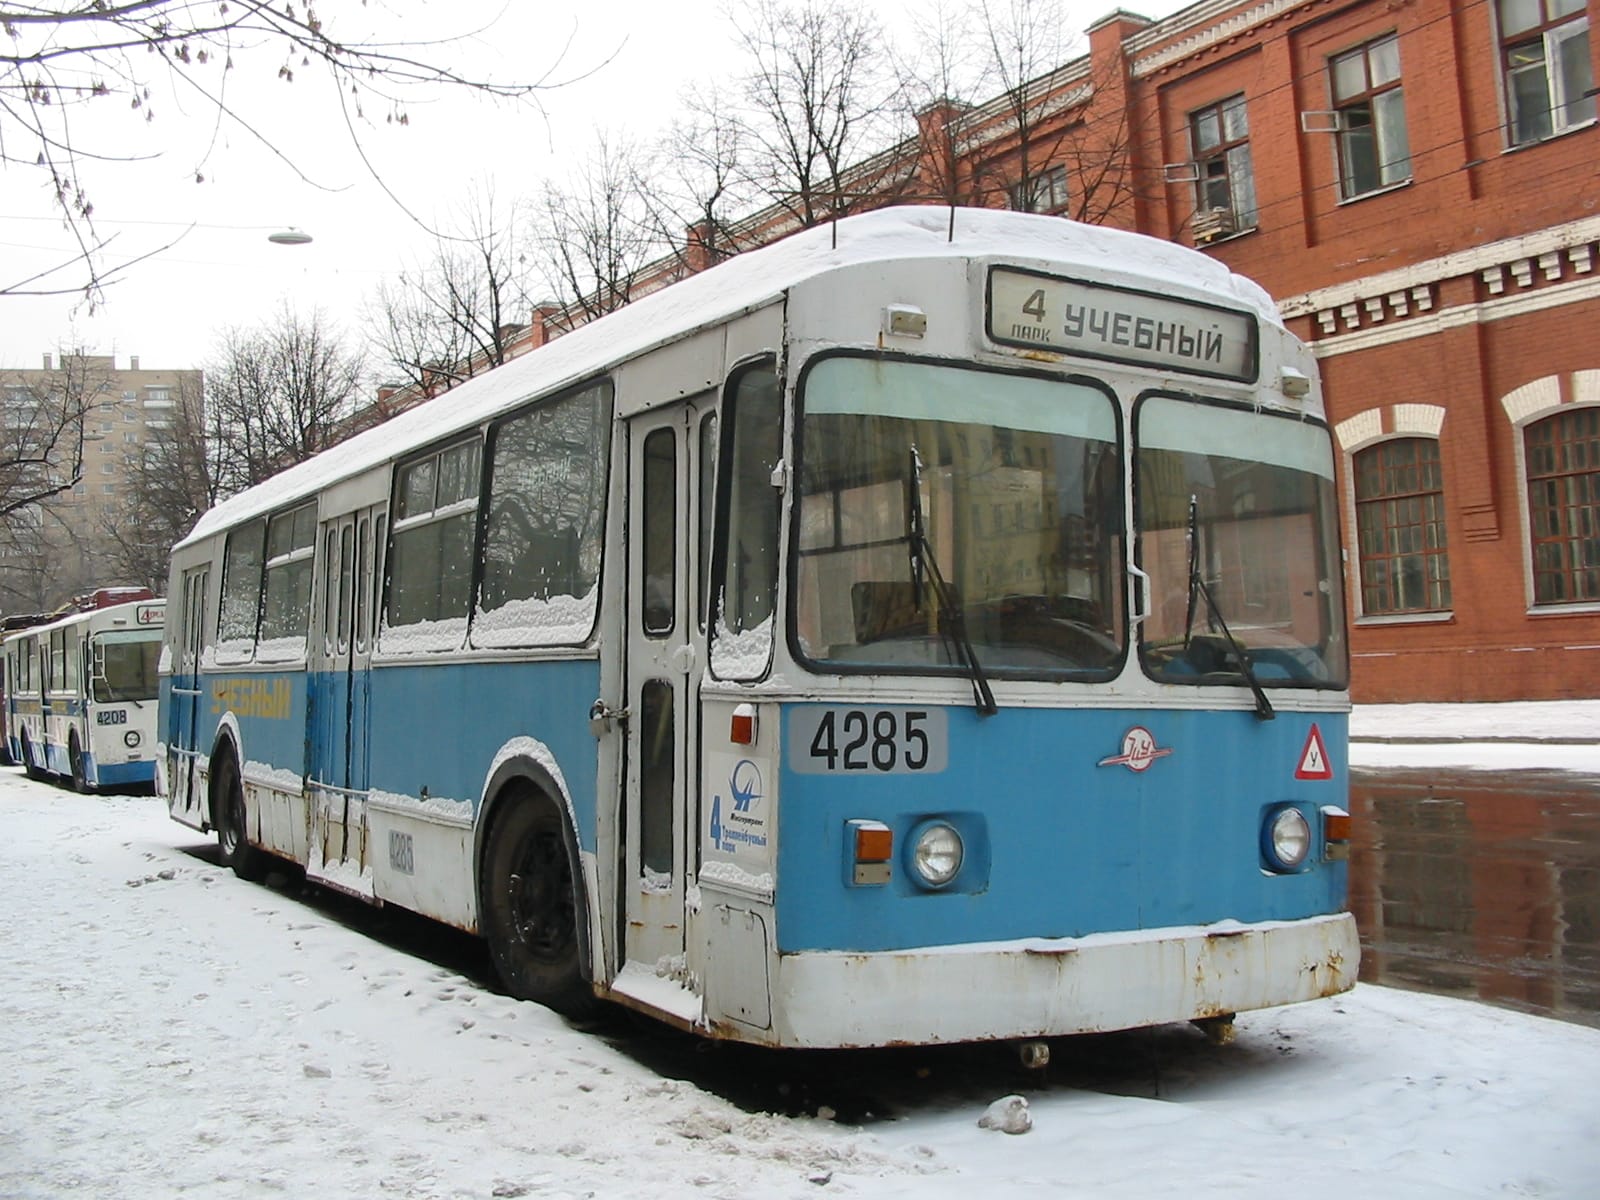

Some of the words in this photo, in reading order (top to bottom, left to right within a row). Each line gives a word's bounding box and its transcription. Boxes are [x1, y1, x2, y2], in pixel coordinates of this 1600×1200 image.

[1022, 289, 1046, 322] 4
[1011, 324, 1050, 342] ПАРК
[1064, 303, 1223, 363] УЧЕБНЫЙ
[97, 710, 127, 725] 4208
[810, 711, 929, 771] 4285
[710, 795, 721, 849] 4
